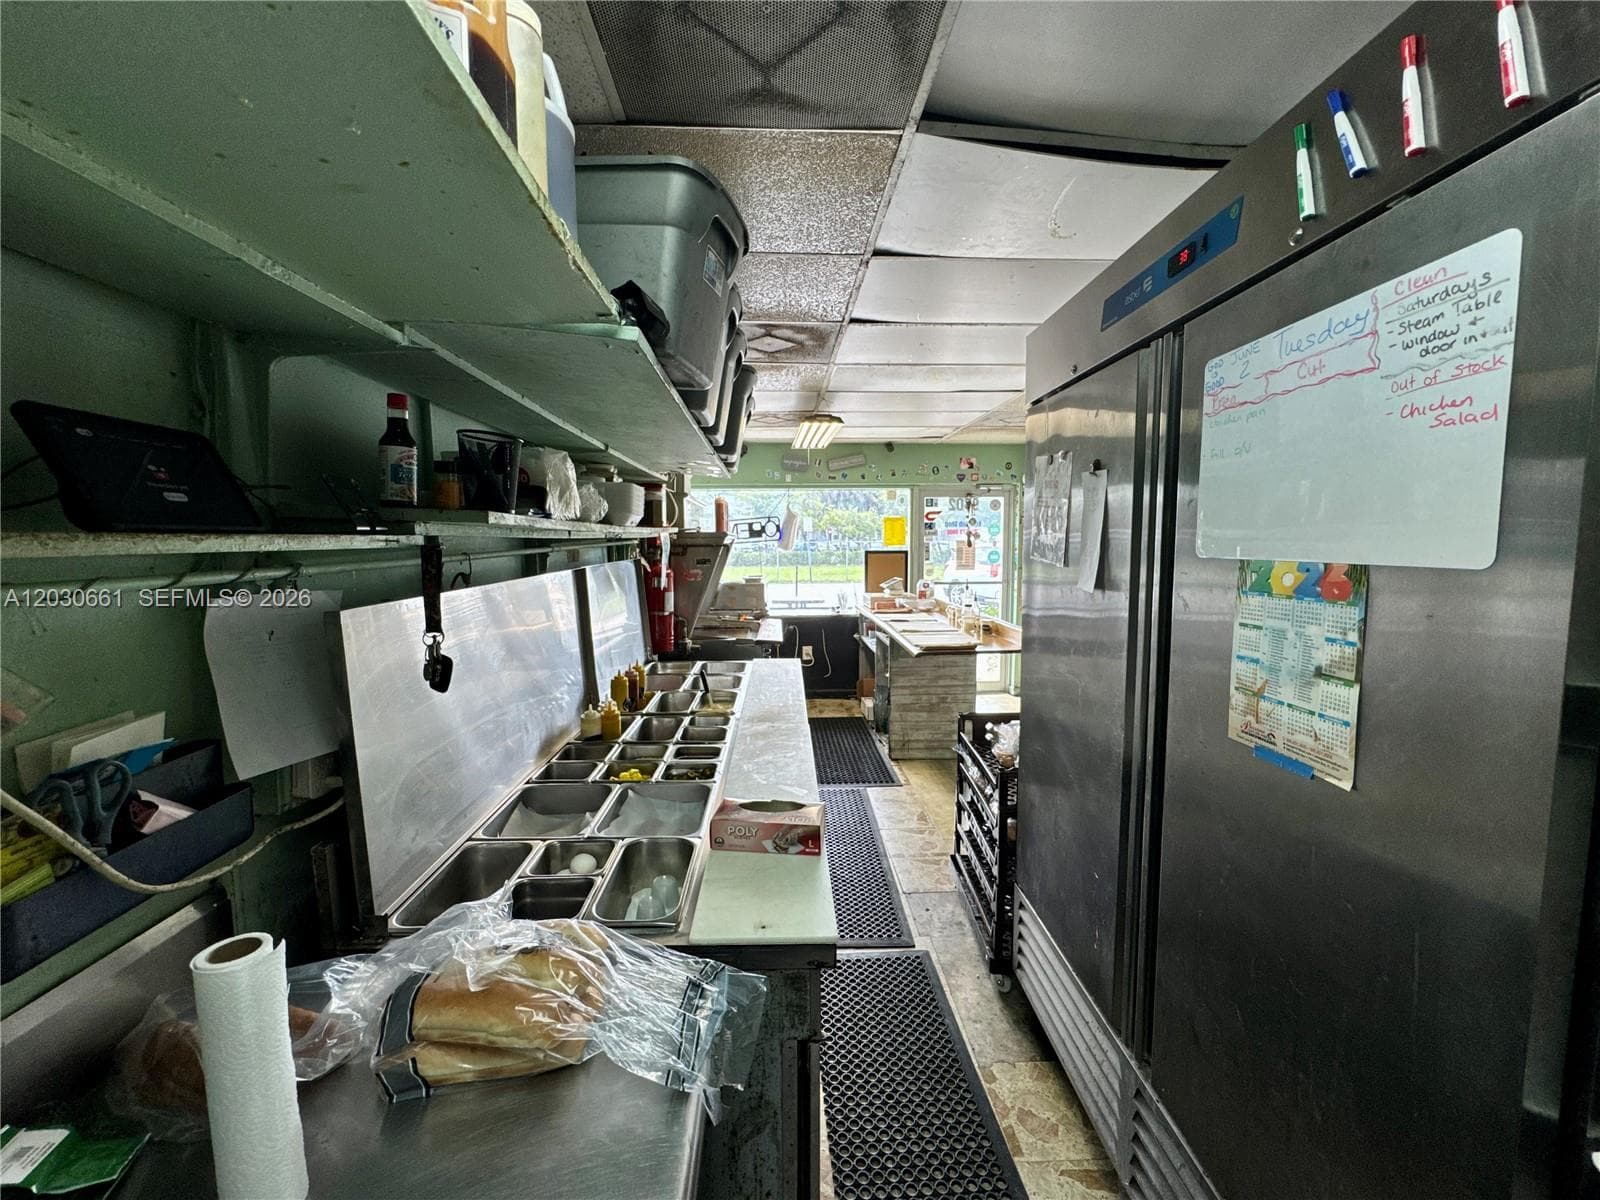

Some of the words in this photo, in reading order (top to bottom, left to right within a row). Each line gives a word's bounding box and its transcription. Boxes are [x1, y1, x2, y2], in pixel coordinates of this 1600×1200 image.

[1397, 311, 1445, 336] Steam
[1452, 289, 1503, 317] Table
[1273, 308, 1370, 359] Tuesday
[1231, 341, 1262, 366] JUNE
[1419, 339, 1457, 358] door
[1239, 359, 1251, 379] 2
[1423, 369, 1441, 386] of
[1429, 403, 1499, 429] Salad
[1247, 559, 1352, 602] 2026
[727, 825, 759, 837] POLY
